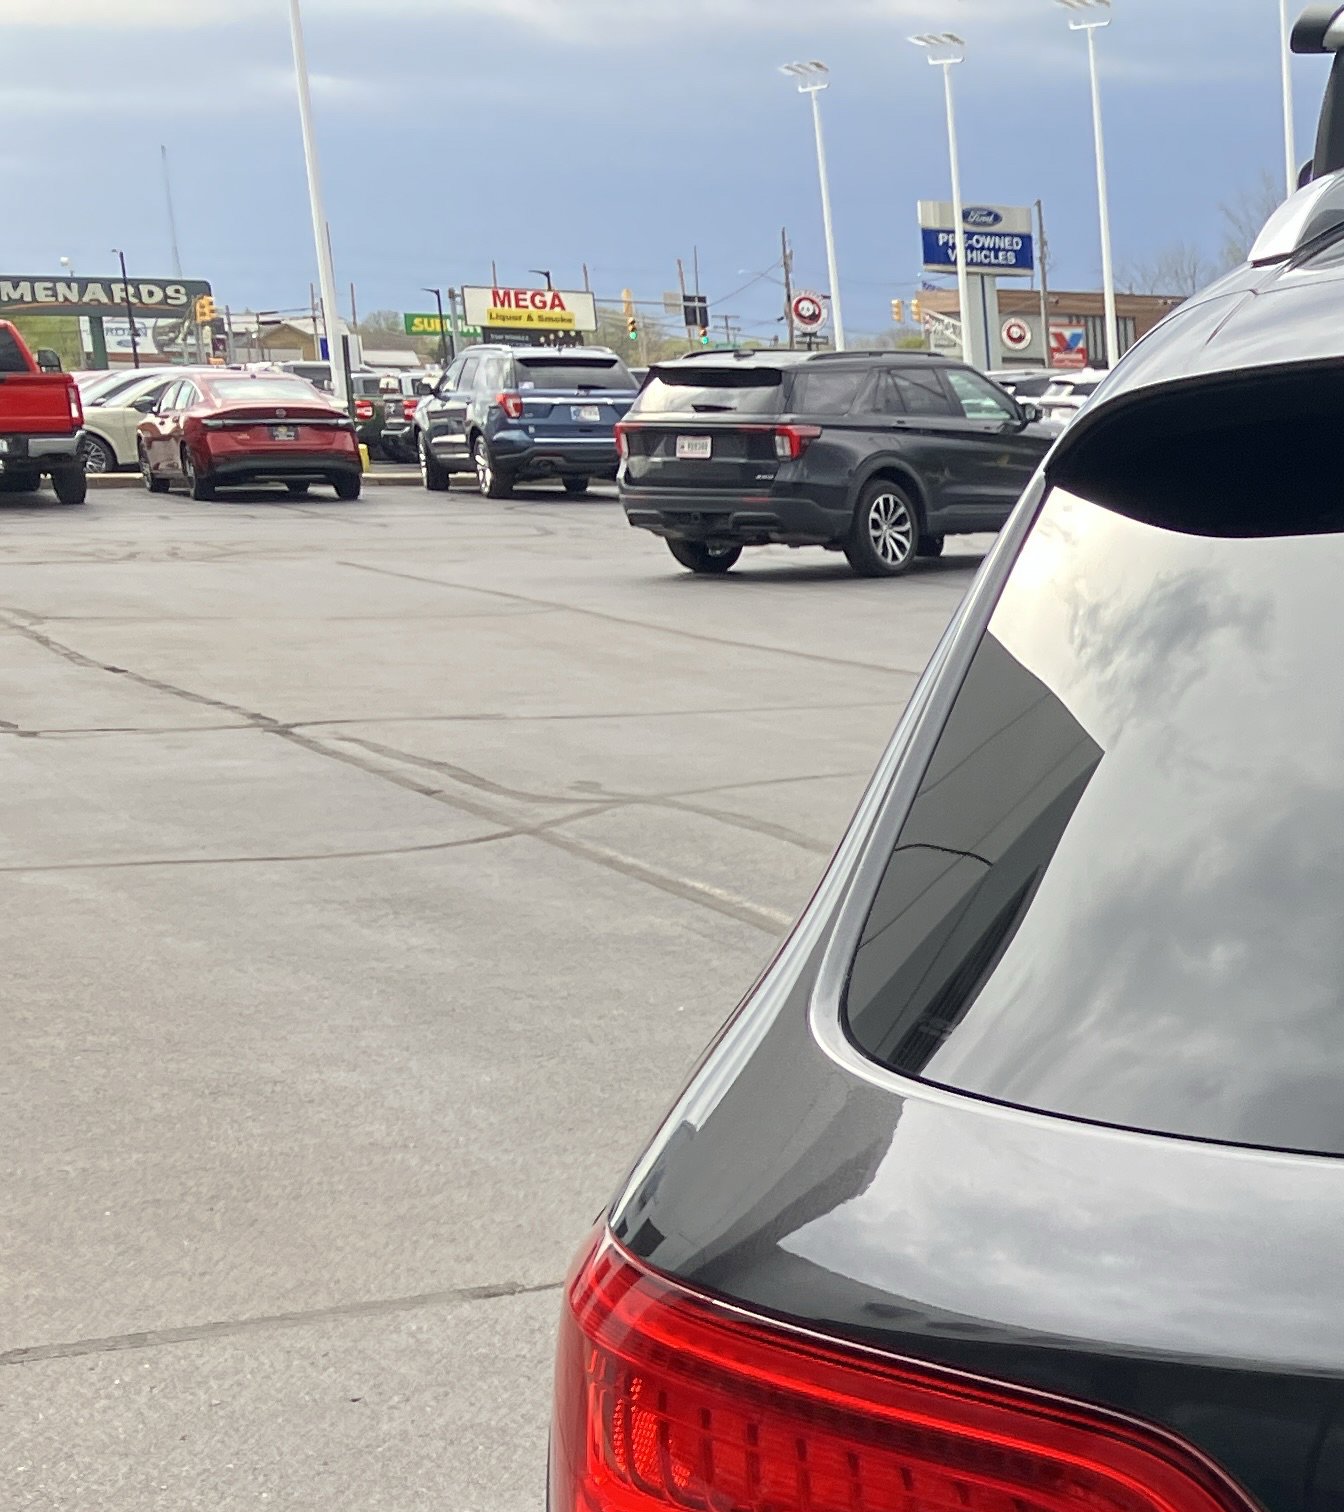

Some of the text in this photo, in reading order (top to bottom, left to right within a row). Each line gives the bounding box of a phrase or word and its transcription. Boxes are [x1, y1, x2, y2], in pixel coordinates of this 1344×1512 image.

[947, 247, 1016, 264] VHICLES
[0, 280, 188, 305] MENARDS
[491, 288, 566, 311] MEGA
